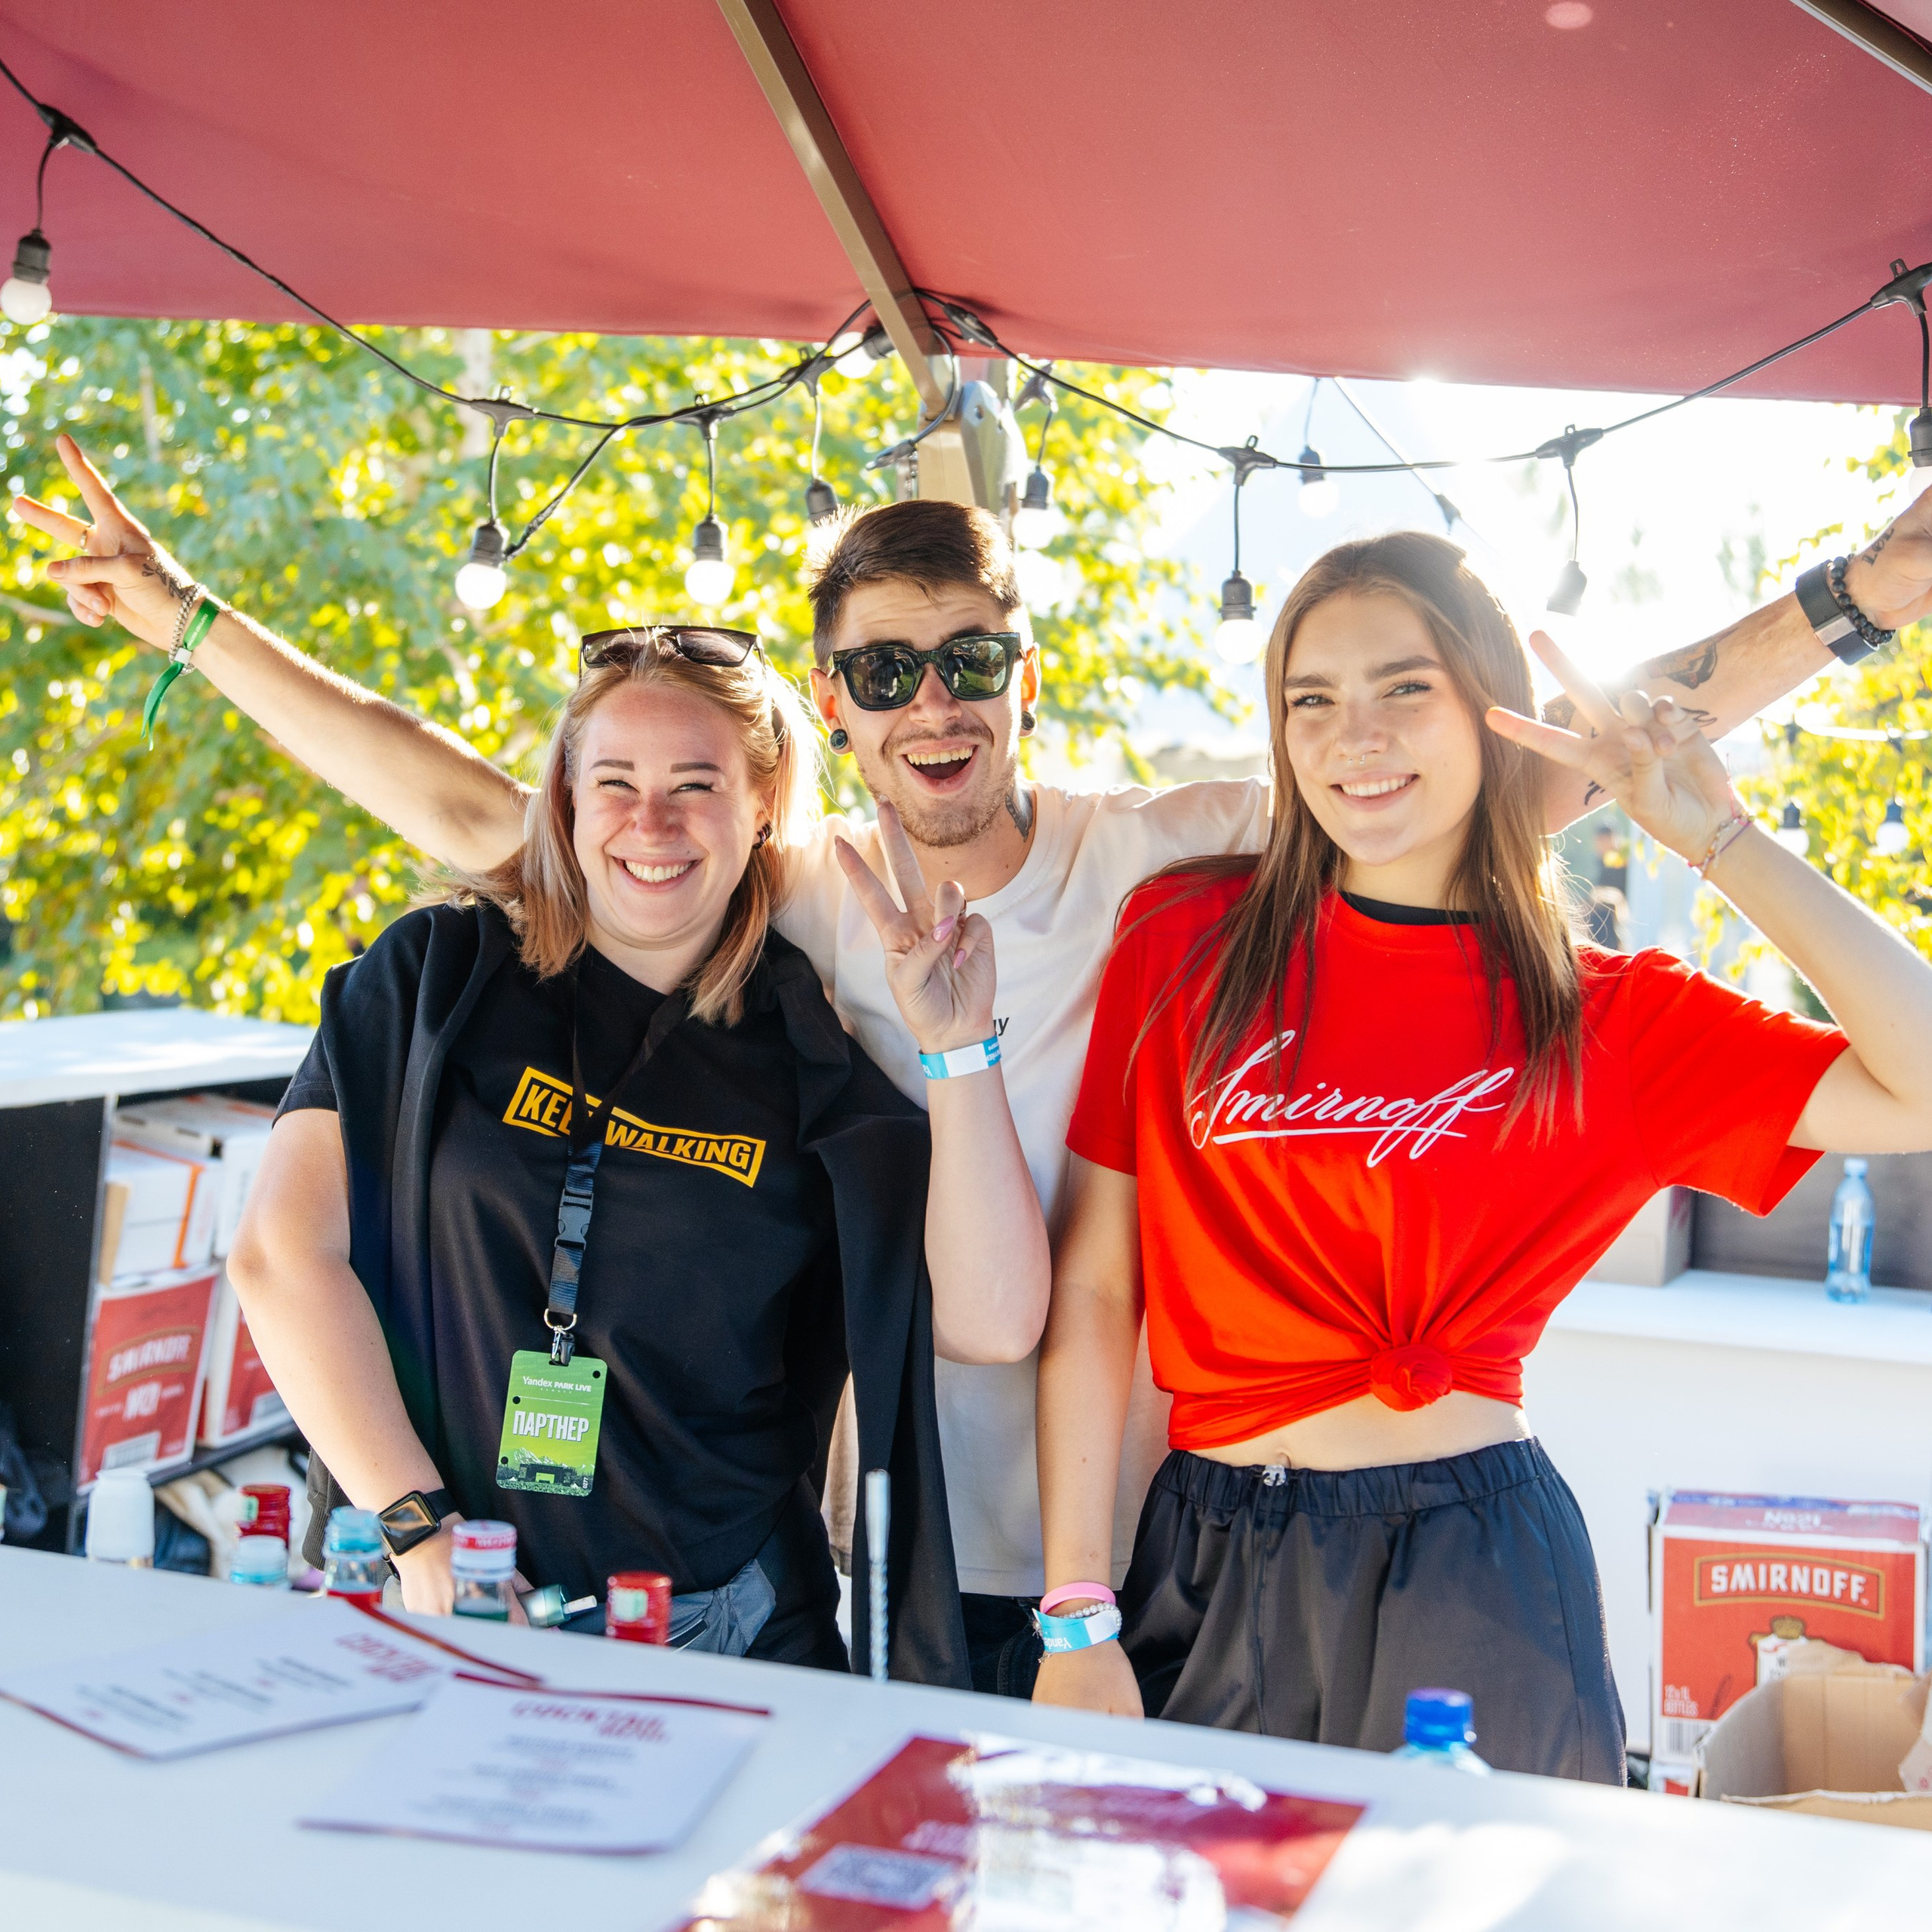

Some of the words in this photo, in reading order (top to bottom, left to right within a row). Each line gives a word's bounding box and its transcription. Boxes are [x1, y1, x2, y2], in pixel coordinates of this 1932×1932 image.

[1187, 1029, 1515, 1168] Smirnoff
[605, 1119, 752, 1170] WALKING
[522, 1376, 552, 1388] Yandex
[554, 1381, 574, 1390] PARK
[575, 1383, 592, 1392] LIVE
[512, 1410, 590, 1442] ПАРТНЕР
[1711, 1563, 1867, 1602] SMIRNOFF
